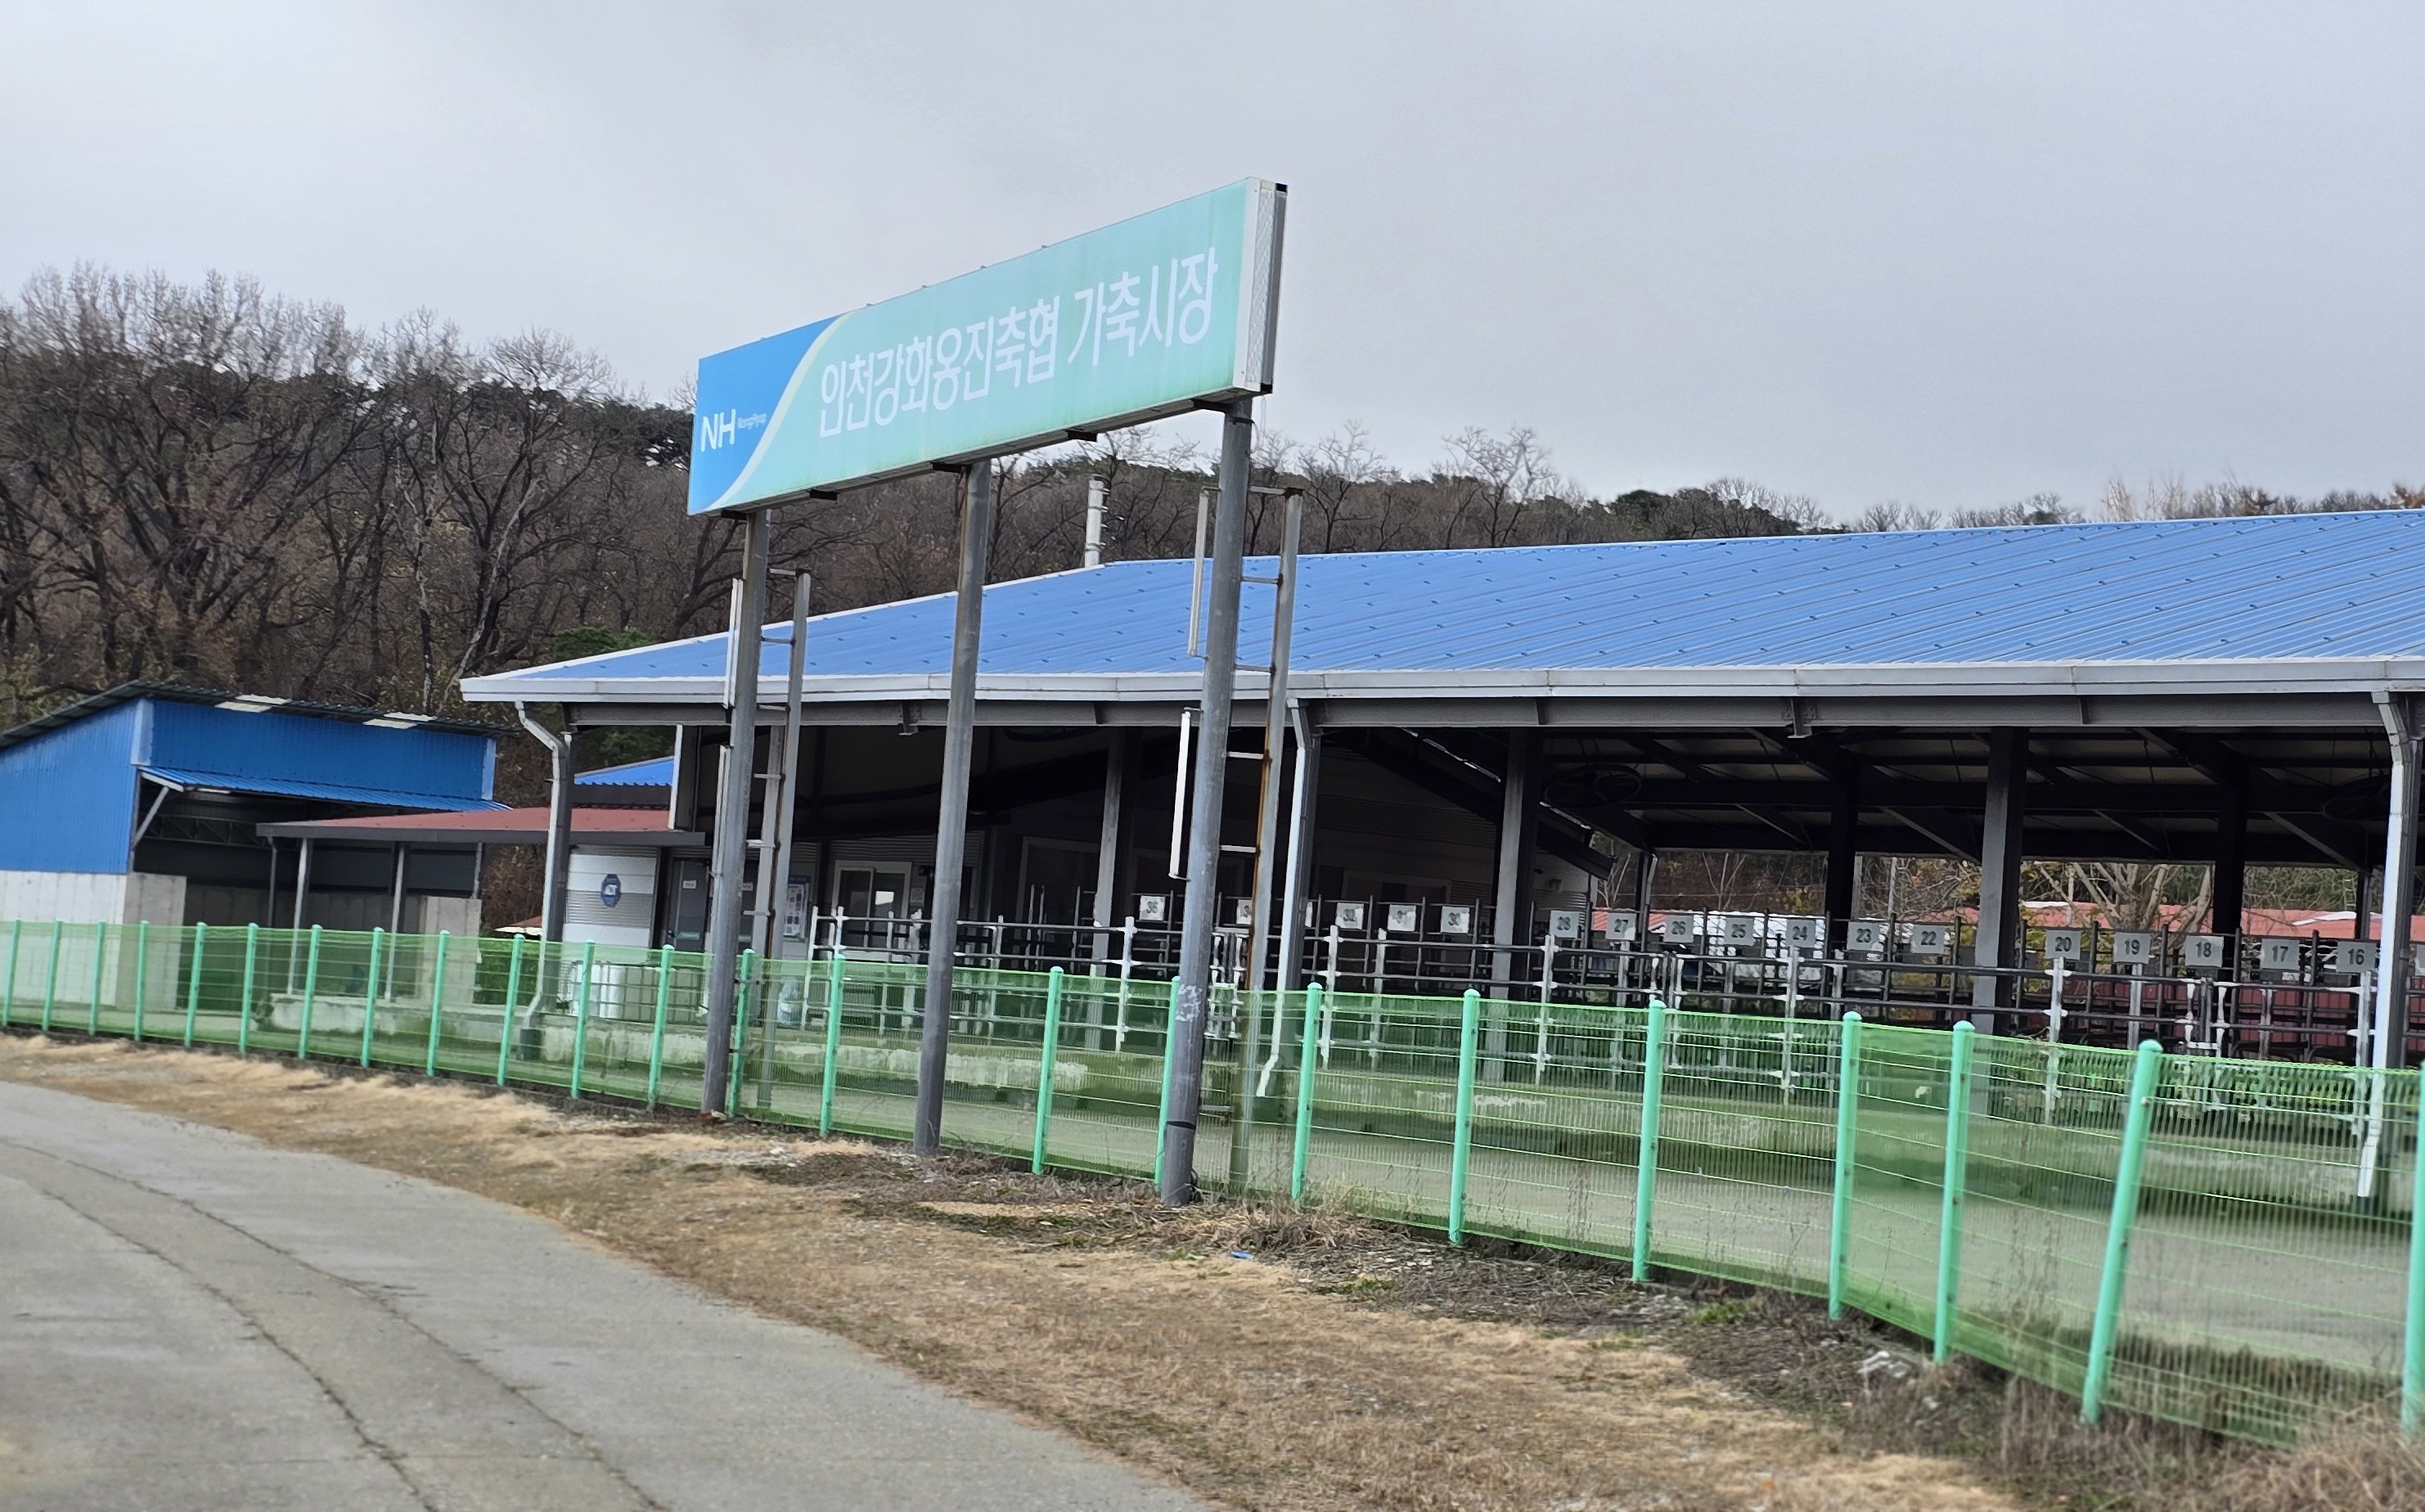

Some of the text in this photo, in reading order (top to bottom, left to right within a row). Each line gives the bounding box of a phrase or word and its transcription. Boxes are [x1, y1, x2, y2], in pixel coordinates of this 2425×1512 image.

[820, 246, 1219, 438] 인천강화옹진축협 가축시장
[701, 408, 736, 452] NH
[1613, 918, 1629, 933] 27
[1731, 924, 1747, 938] 25
[1792, 925, 1808, 940] 24
[1856, 928, 1872, 943] 23
[1920, 930, 1937, 946] 22
[2054, 936, 2072, 952] 20
[2124, 938, 2141, 955] 19
[2195, 942, 2212, 958] 18
[2272, 945, 2289, 963] 17
[2347, 948, 2365, 965] 16
